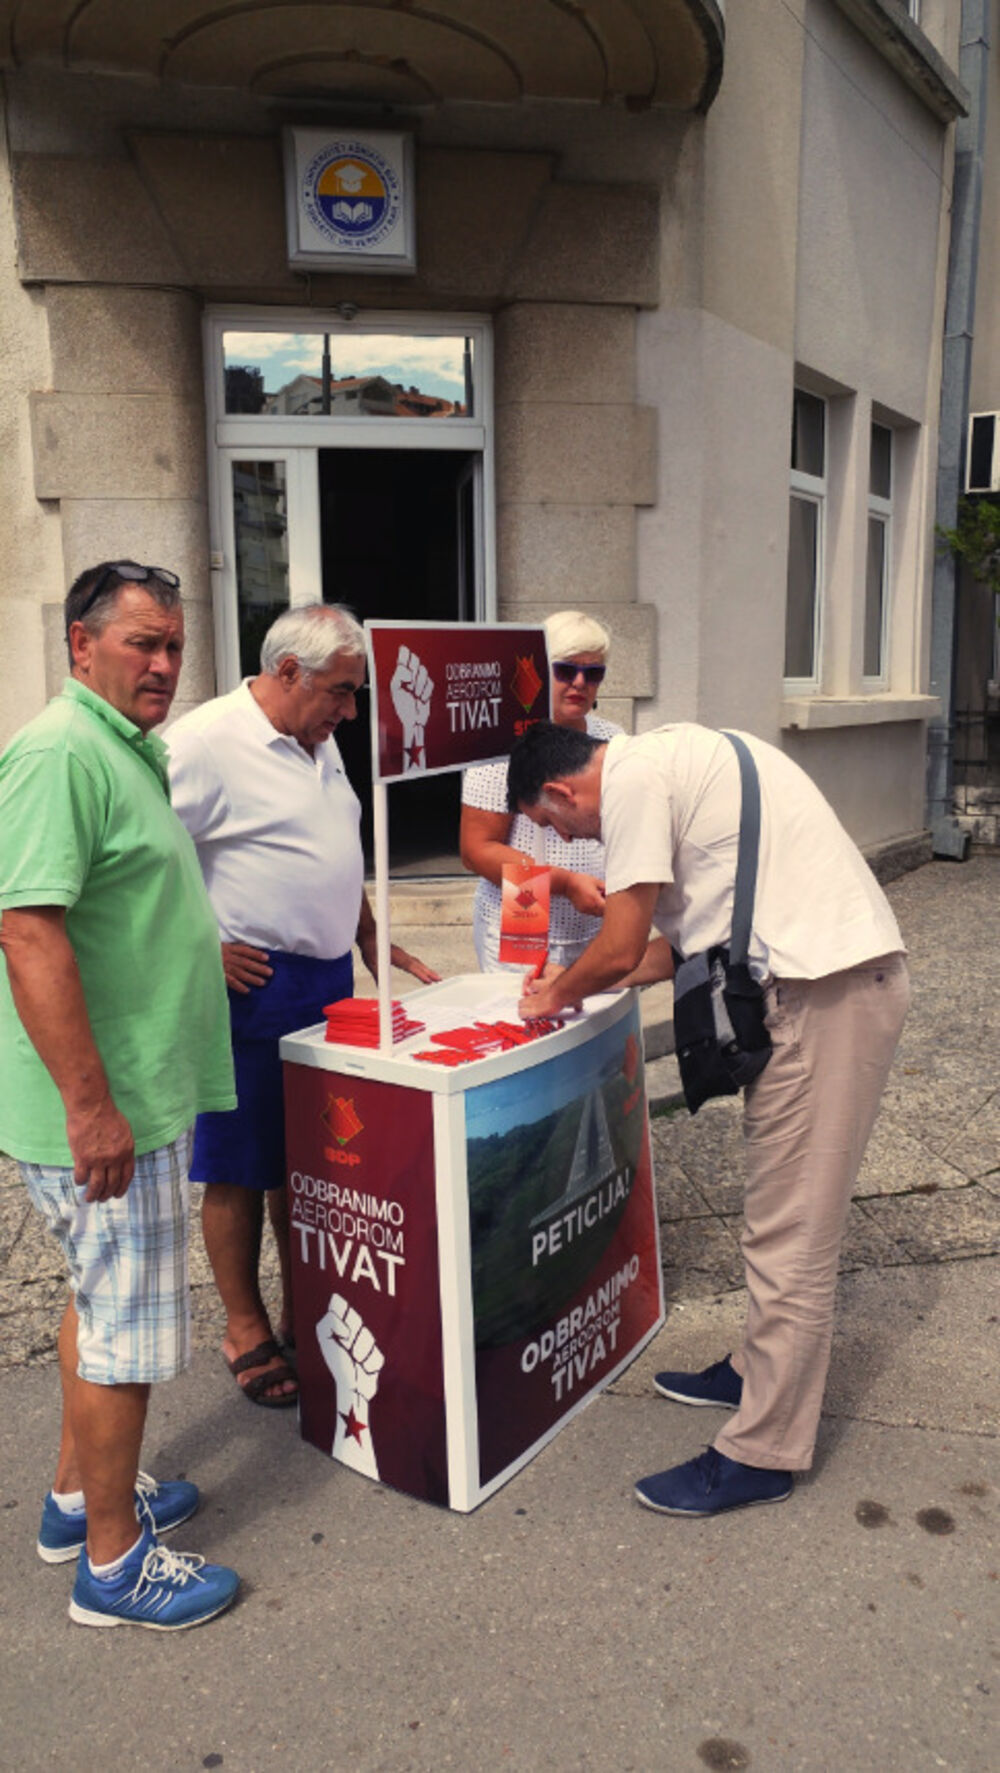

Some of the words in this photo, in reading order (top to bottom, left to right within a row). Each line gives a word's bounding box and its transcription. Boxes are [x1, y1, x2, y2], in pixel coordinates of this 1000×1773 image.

[445, 661, 501, 681] ODBRANIMO
[446, 680, 502, 700] AERODROM
[446, 697, 502, 733] TIVAT
[324, 1146, 362, 1167] SDP
[290, 1171, 405, 1227] ODBRANIMO
[291, 1198, 405, 1254] AERODROM
[531, 1167, 632, 1267] PETICIJA!
[291, 1220, 406, 1297] TIVAT
[520, 1253, 640, 1374] ODBRANIMO
[553, 1301, 621, 1371] AERODROM
[551, 1317, 621, 1402] TIVAT
